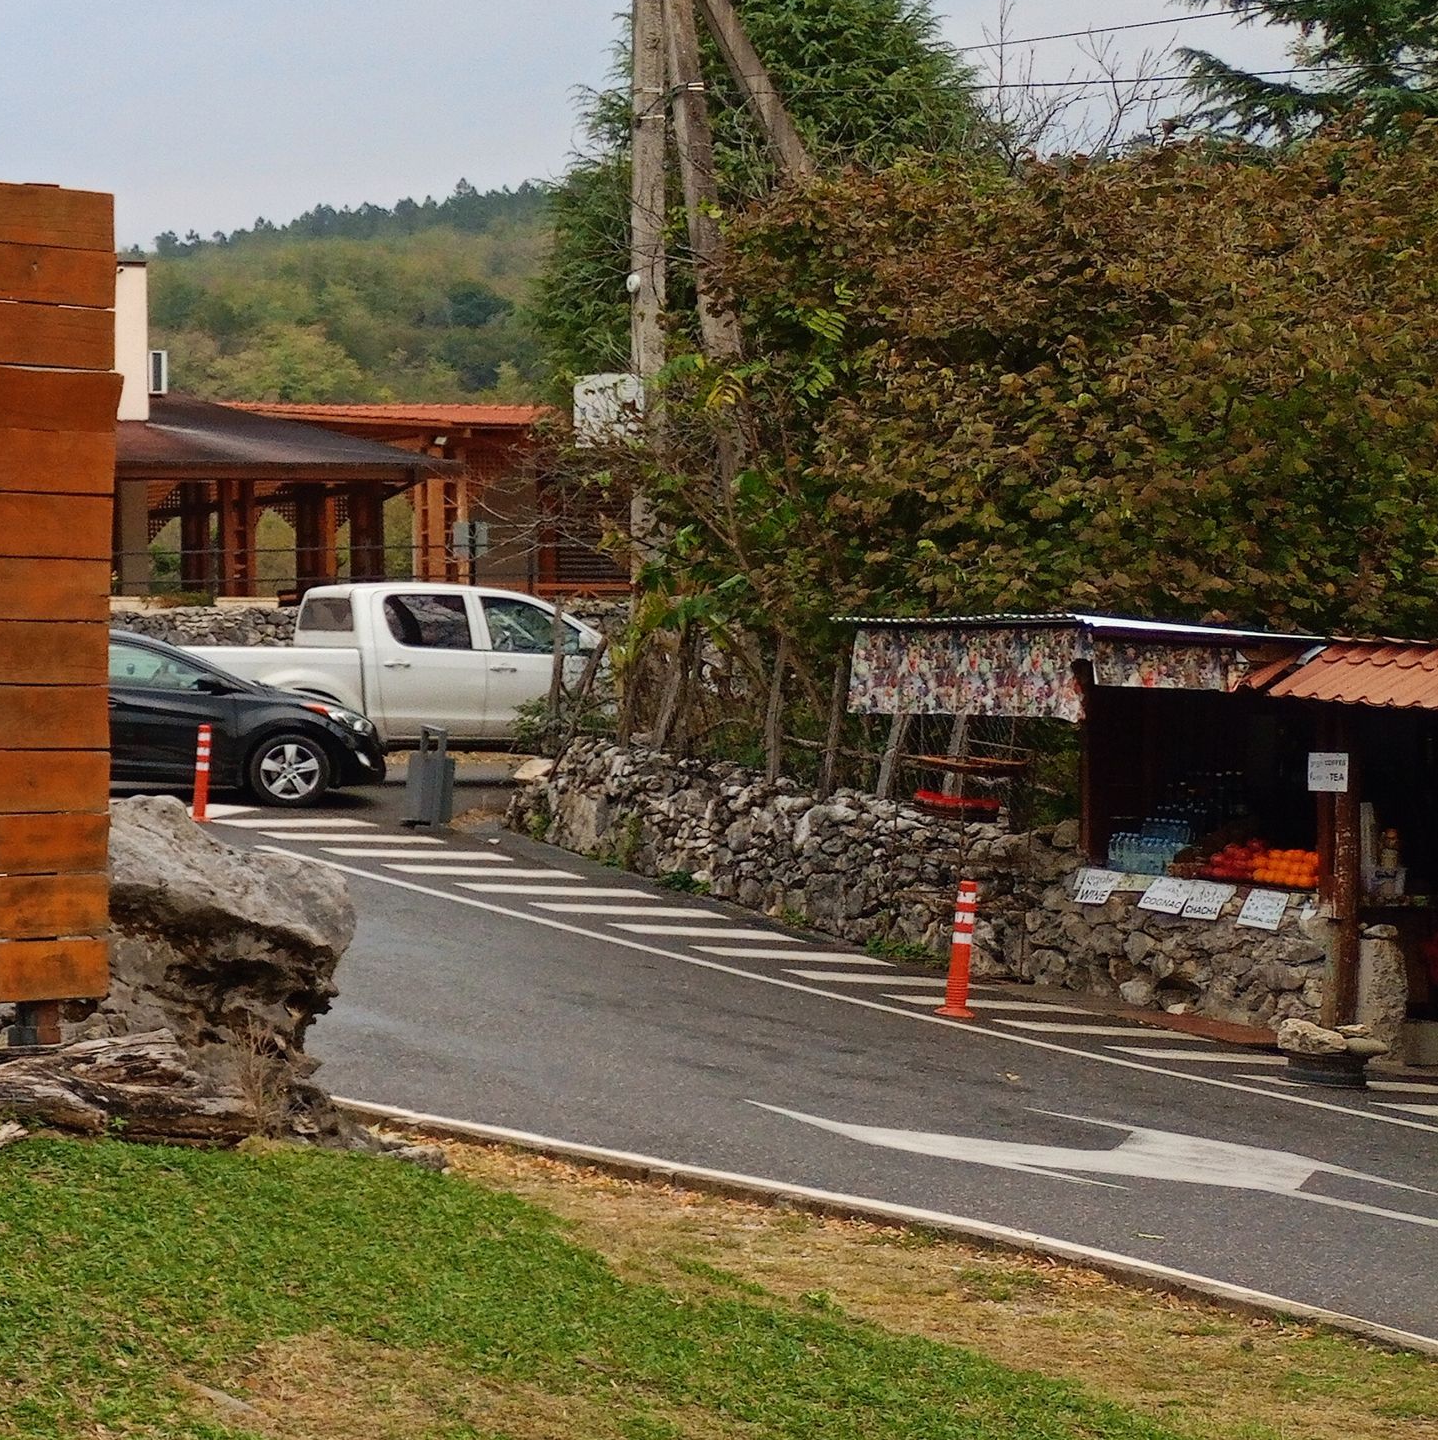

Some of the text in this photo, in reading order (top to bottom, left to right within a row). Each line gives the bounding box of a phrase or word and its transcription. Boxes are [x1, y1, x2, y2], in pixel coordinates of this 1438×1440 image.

[1329, 773, 1344, 781] TEA
[1080, 889, 1108, 901] WINE
[1143, 896, 1182, 909] COGNAC
[1185, 905, 1218, 915] CHACHA
